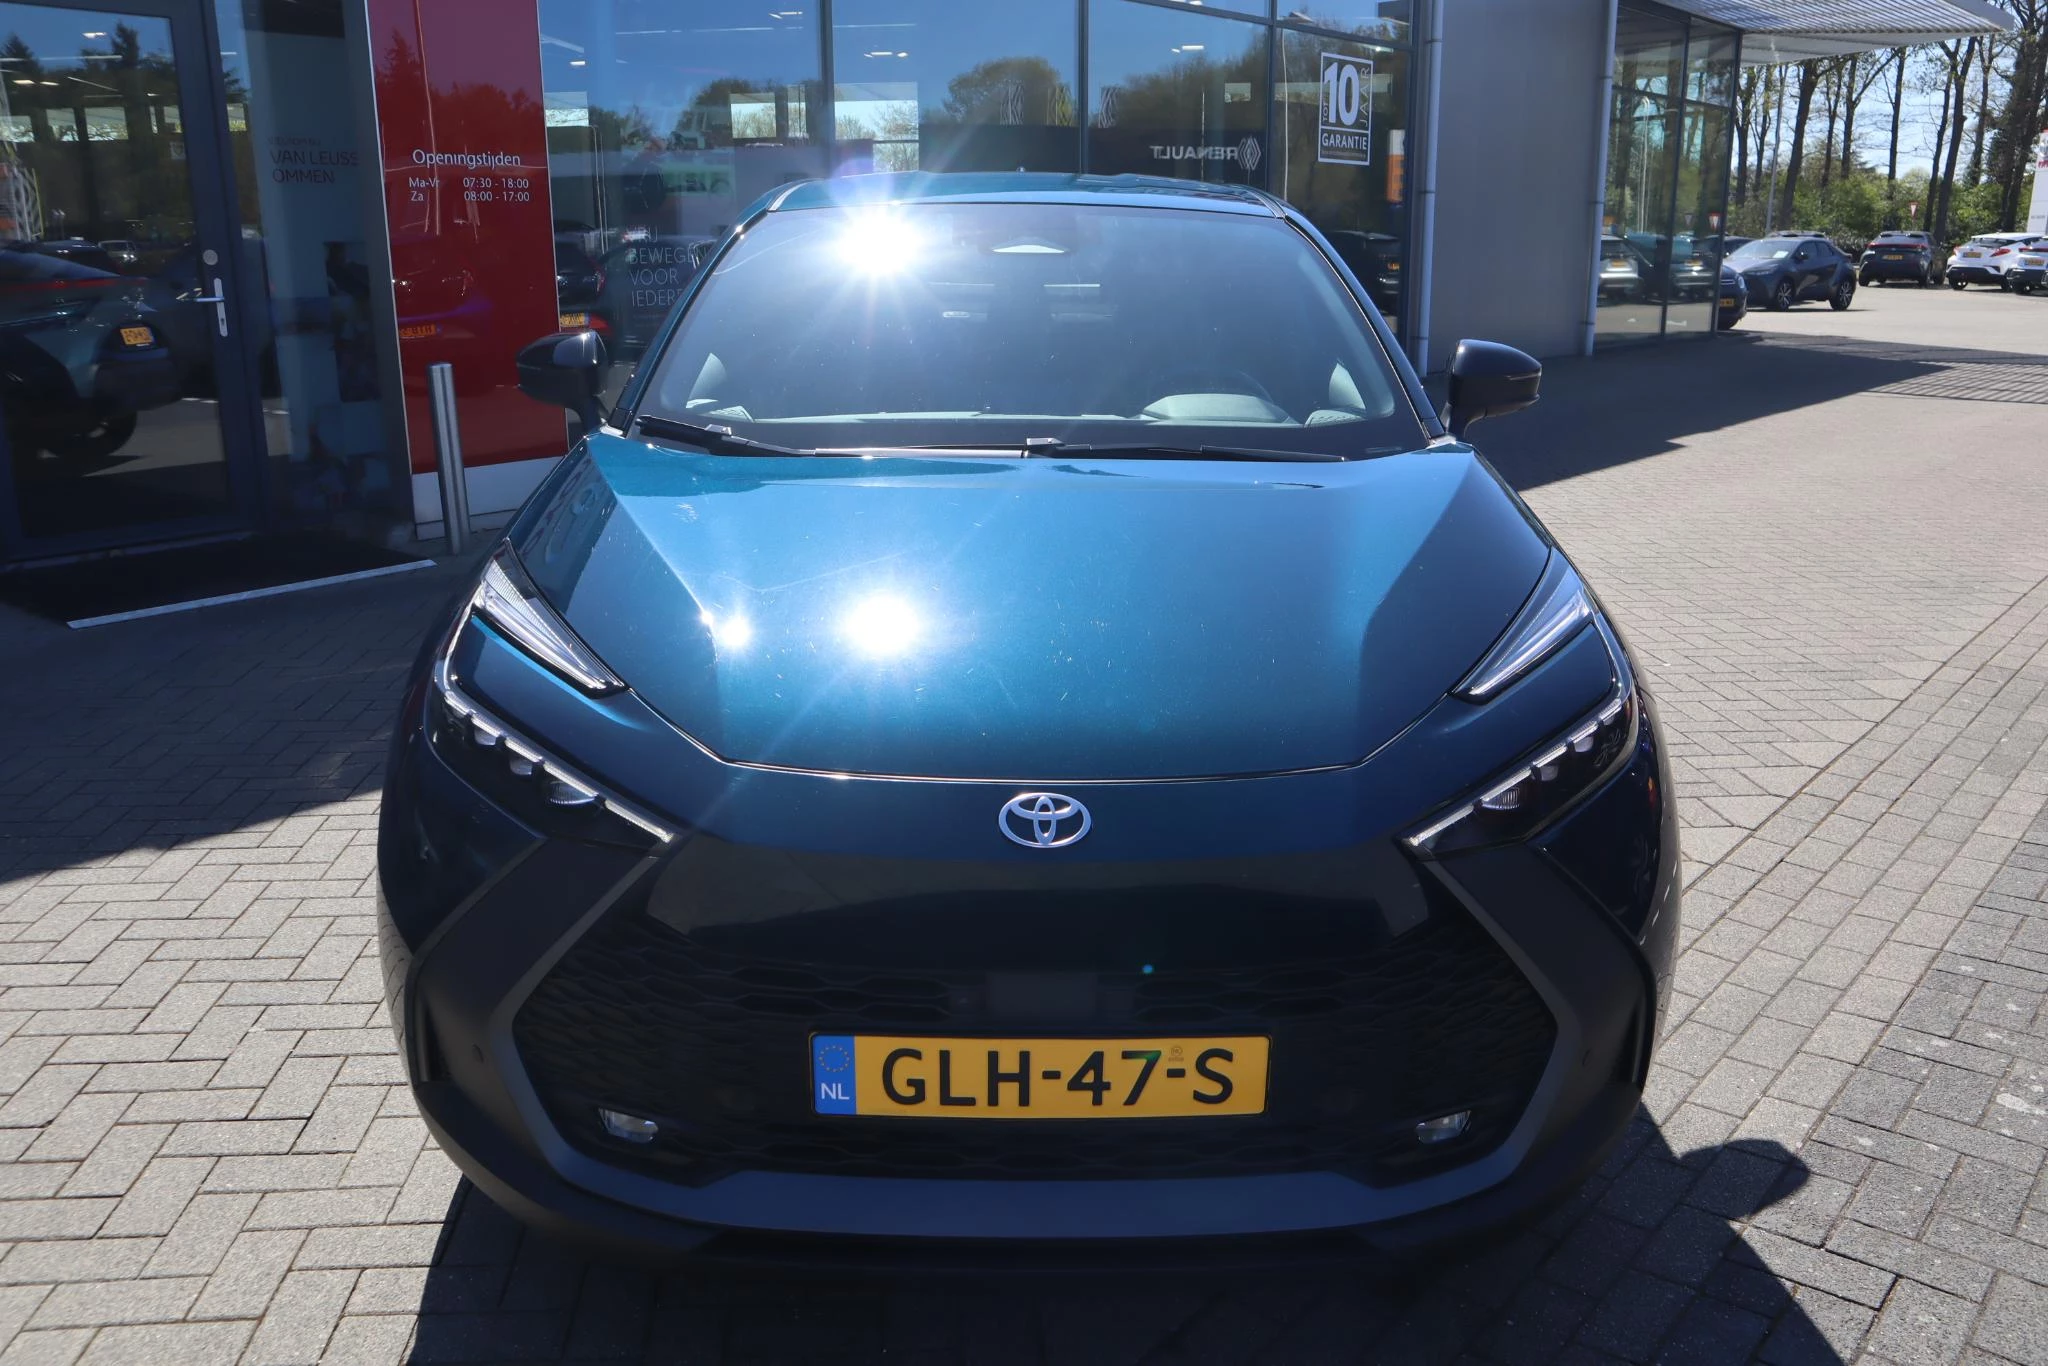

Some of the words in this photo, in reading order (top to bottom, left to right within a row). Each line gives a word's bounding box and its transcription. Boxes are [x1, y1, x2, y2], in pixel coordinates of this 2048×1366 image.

[1323, 62, 1360, 126] 10
[1360, 67, 1370, 128] JAAR
[1321, 132, 1367, 150] GARANTIE
[270, 149, 306, 165] VAN
[412, 149, 521, 170] Openingstijden
[273, 168, 335, 184] OMMEN
[408, 177, 440, 188] Ma-Vr
[463, 177, 492, 188] 07:30
[502, 178, 529, 189] 18:00
[411, 191, 424, 202] Za
[464, 191, 493, 201] 08:00
[503, 191, 530, 202] 17:00
[629, 268, 679, 286] VOOR
[882, 1048, 1234, 1107] GLH-47-S
[820, 1083, 850, 1100] NL
